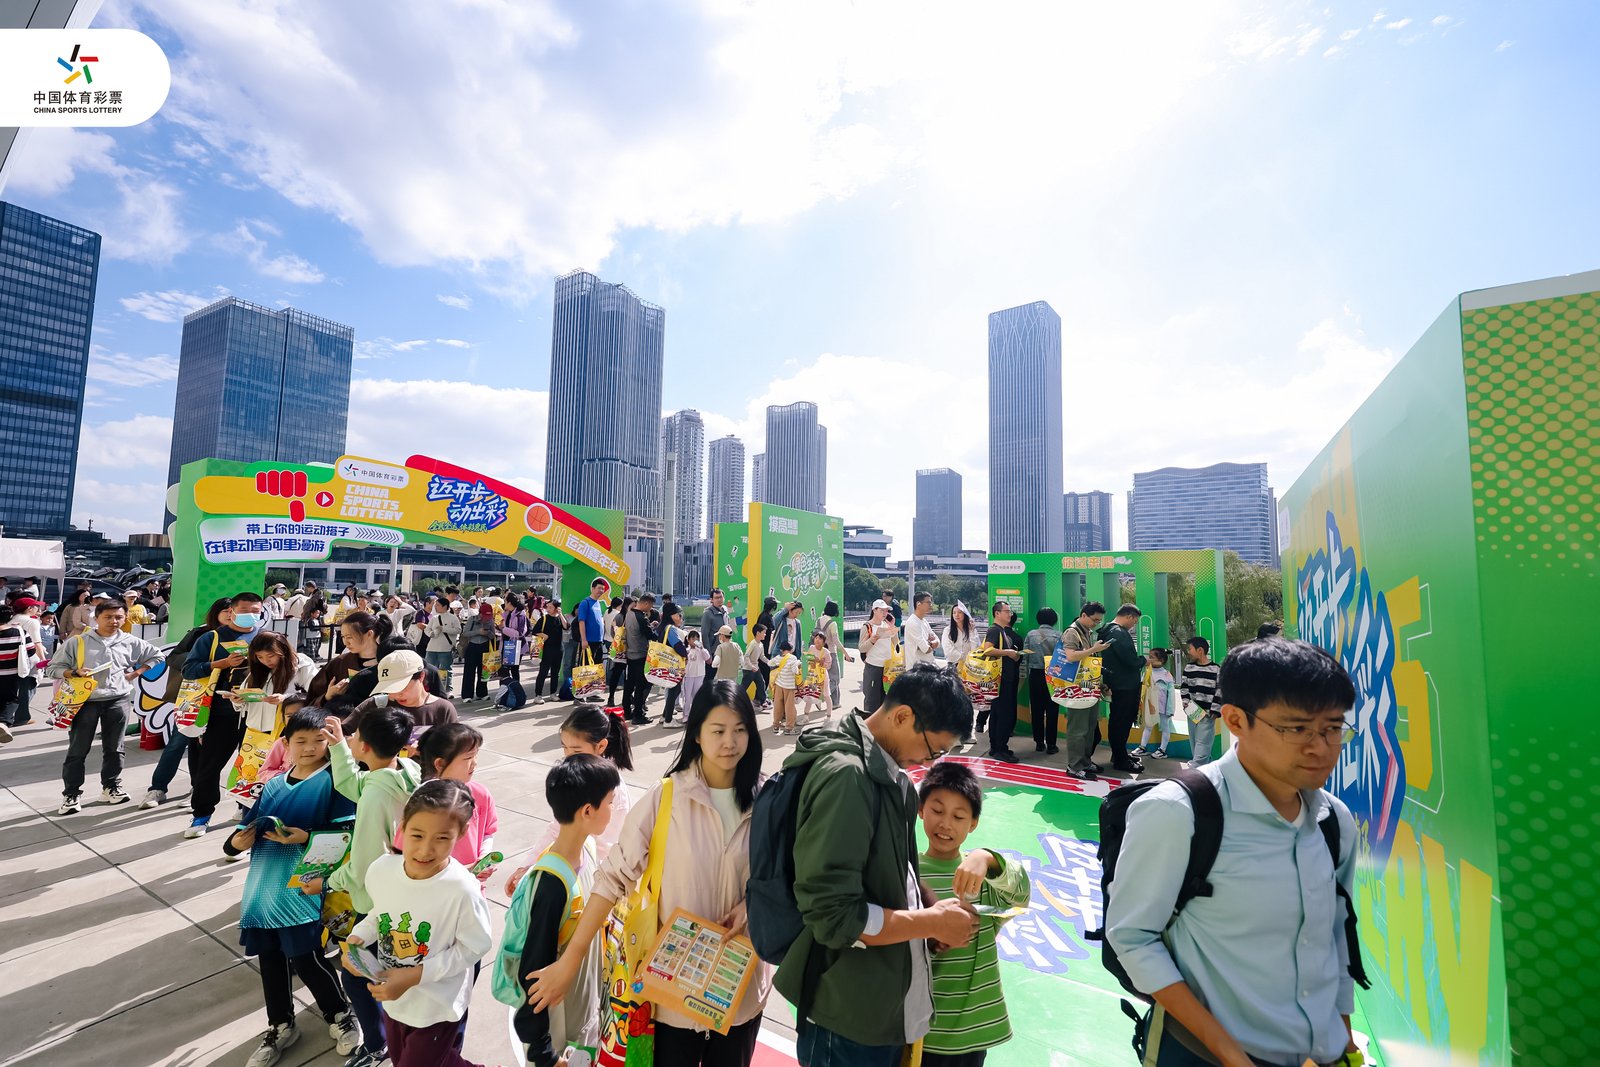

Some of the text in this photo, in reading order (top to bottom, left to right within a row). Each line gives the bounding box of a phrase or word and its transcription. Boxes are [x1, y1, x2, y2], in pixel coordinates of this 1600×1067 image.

[361, 469, 404, 483] 中国体育彩票
[345, 484, 389, 498] CHINA
[428, 476, 492, 504] 迈开步
[342, 494, 400, 510] SPORTS
[340, 505, 404, 521] LOTTERY
[448, 496, 508, 528] 动出彩
[246, 523, 350, 537] 带上你的运动搭子
[204, 538, 326, 555] 在律动星河里漫游
[566, 533, 620, 575] 运动嘉年华
[381, 668, 389, 677] R
